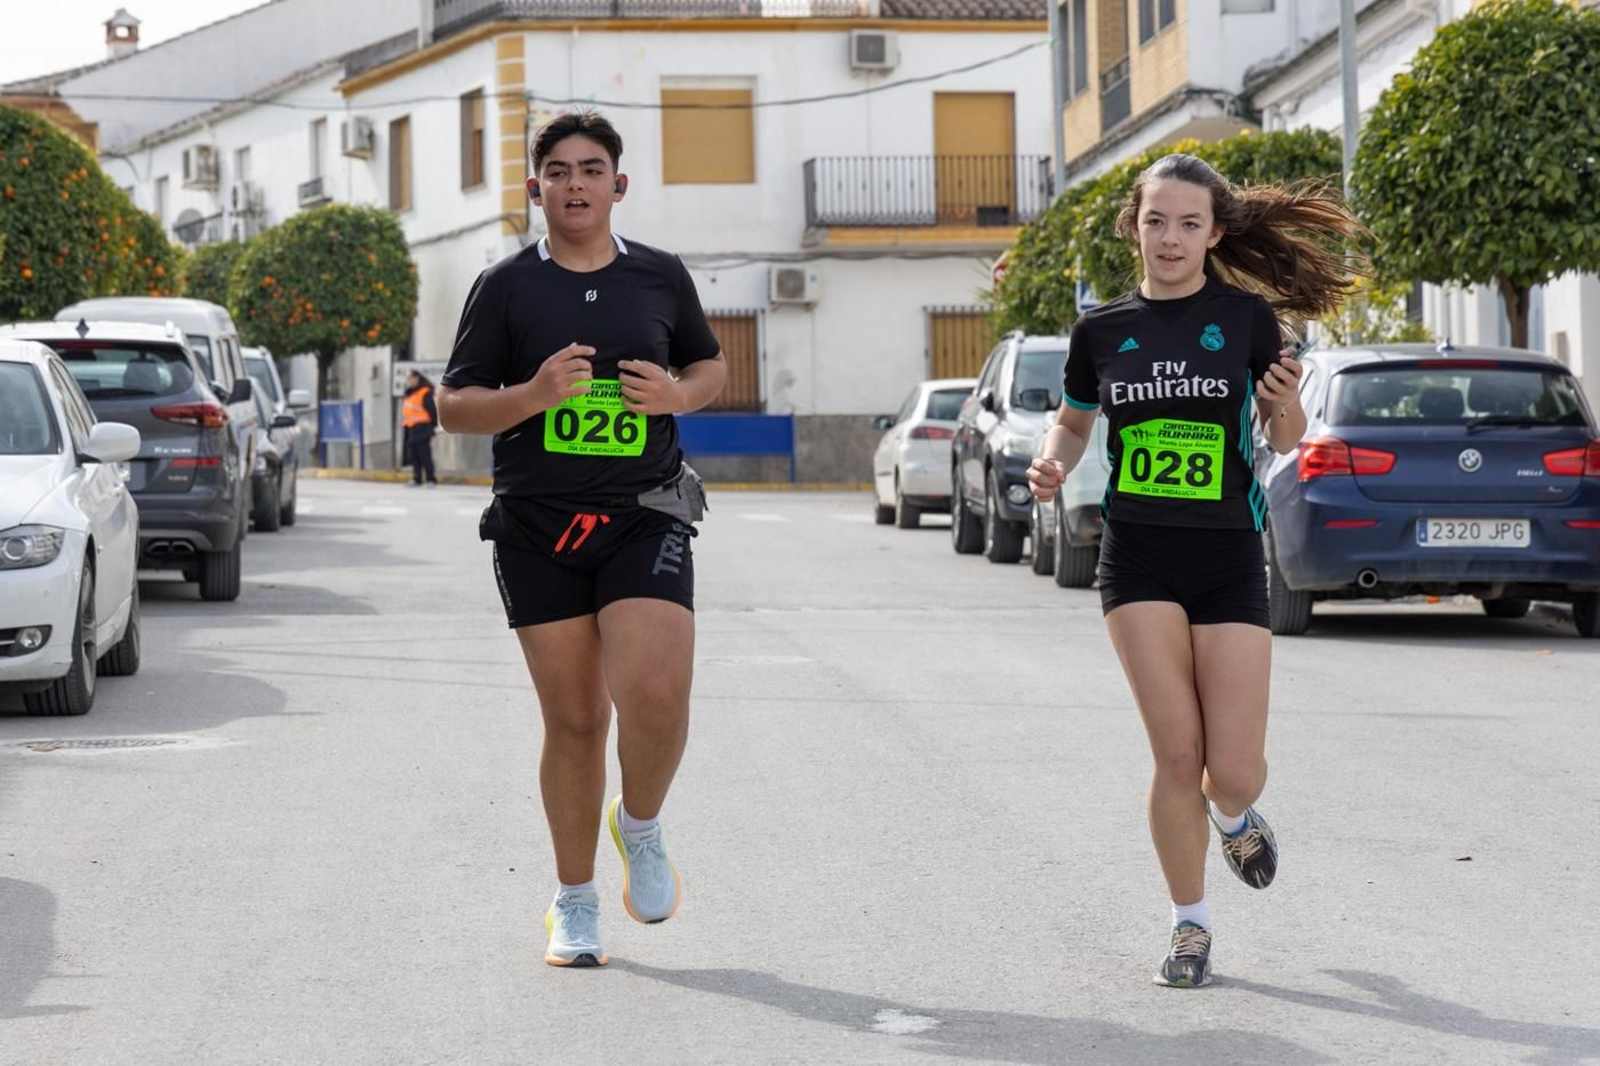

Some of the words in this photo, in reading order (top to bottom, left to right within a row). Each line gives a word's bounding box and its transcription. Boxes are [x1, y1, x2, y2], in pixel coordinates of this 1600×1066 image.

[1152, 361, 1187, 376] Fly
[1110, 375, 1229, 406] Emirates
[554, 408, 639, 445] 026
[1163, 423, 1215, 432] CIRCUITO
[1158, 431, 1220, 441] RUNNING
[1130, 447, 1213, 488] 028
[1432, 522, 1481, 540] 2320
[1488, 522, 1524, 540] JPG
